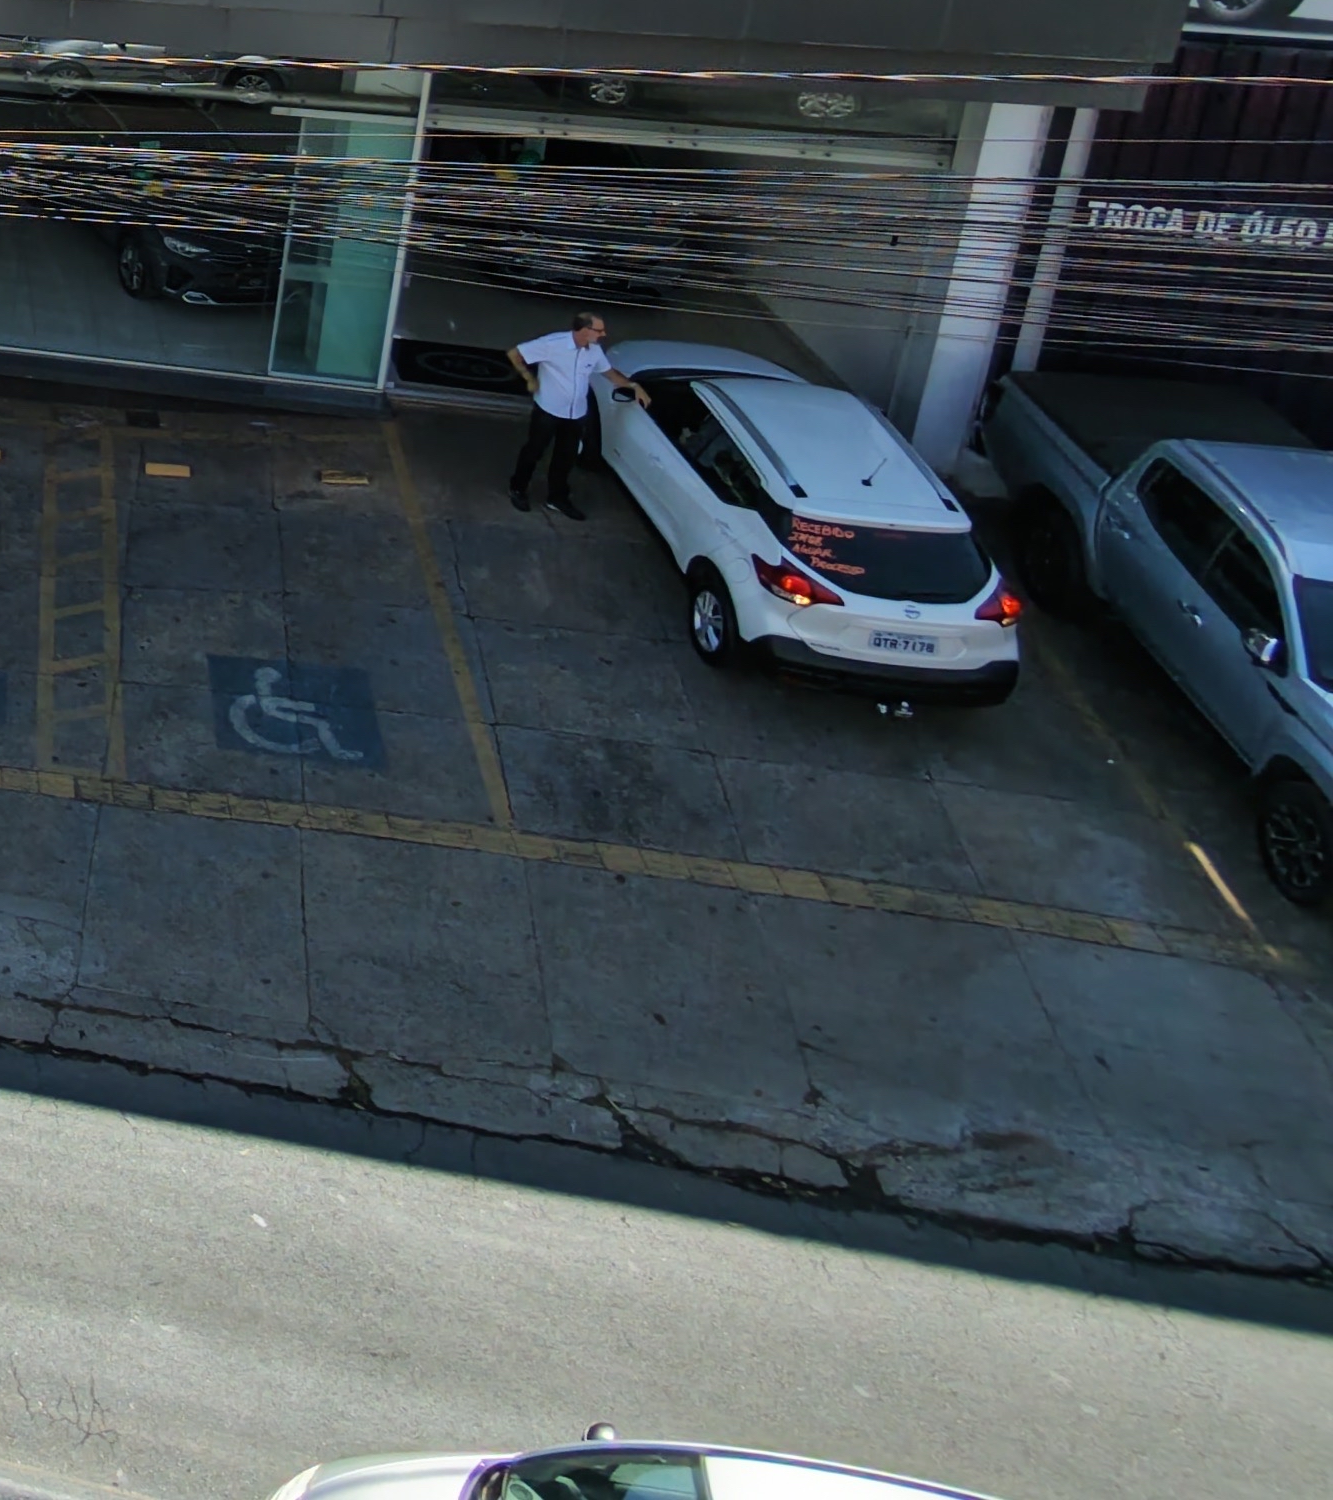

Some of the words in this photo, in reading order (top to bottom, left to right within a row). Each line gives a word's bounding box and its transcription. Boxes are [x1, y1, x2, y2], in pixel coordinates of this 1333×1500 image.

[1088, 201, 1183, 232] TROCA
[1194, 209, 1233, 241] DE
[1241, 209, 1318, 246] ÓLEO
